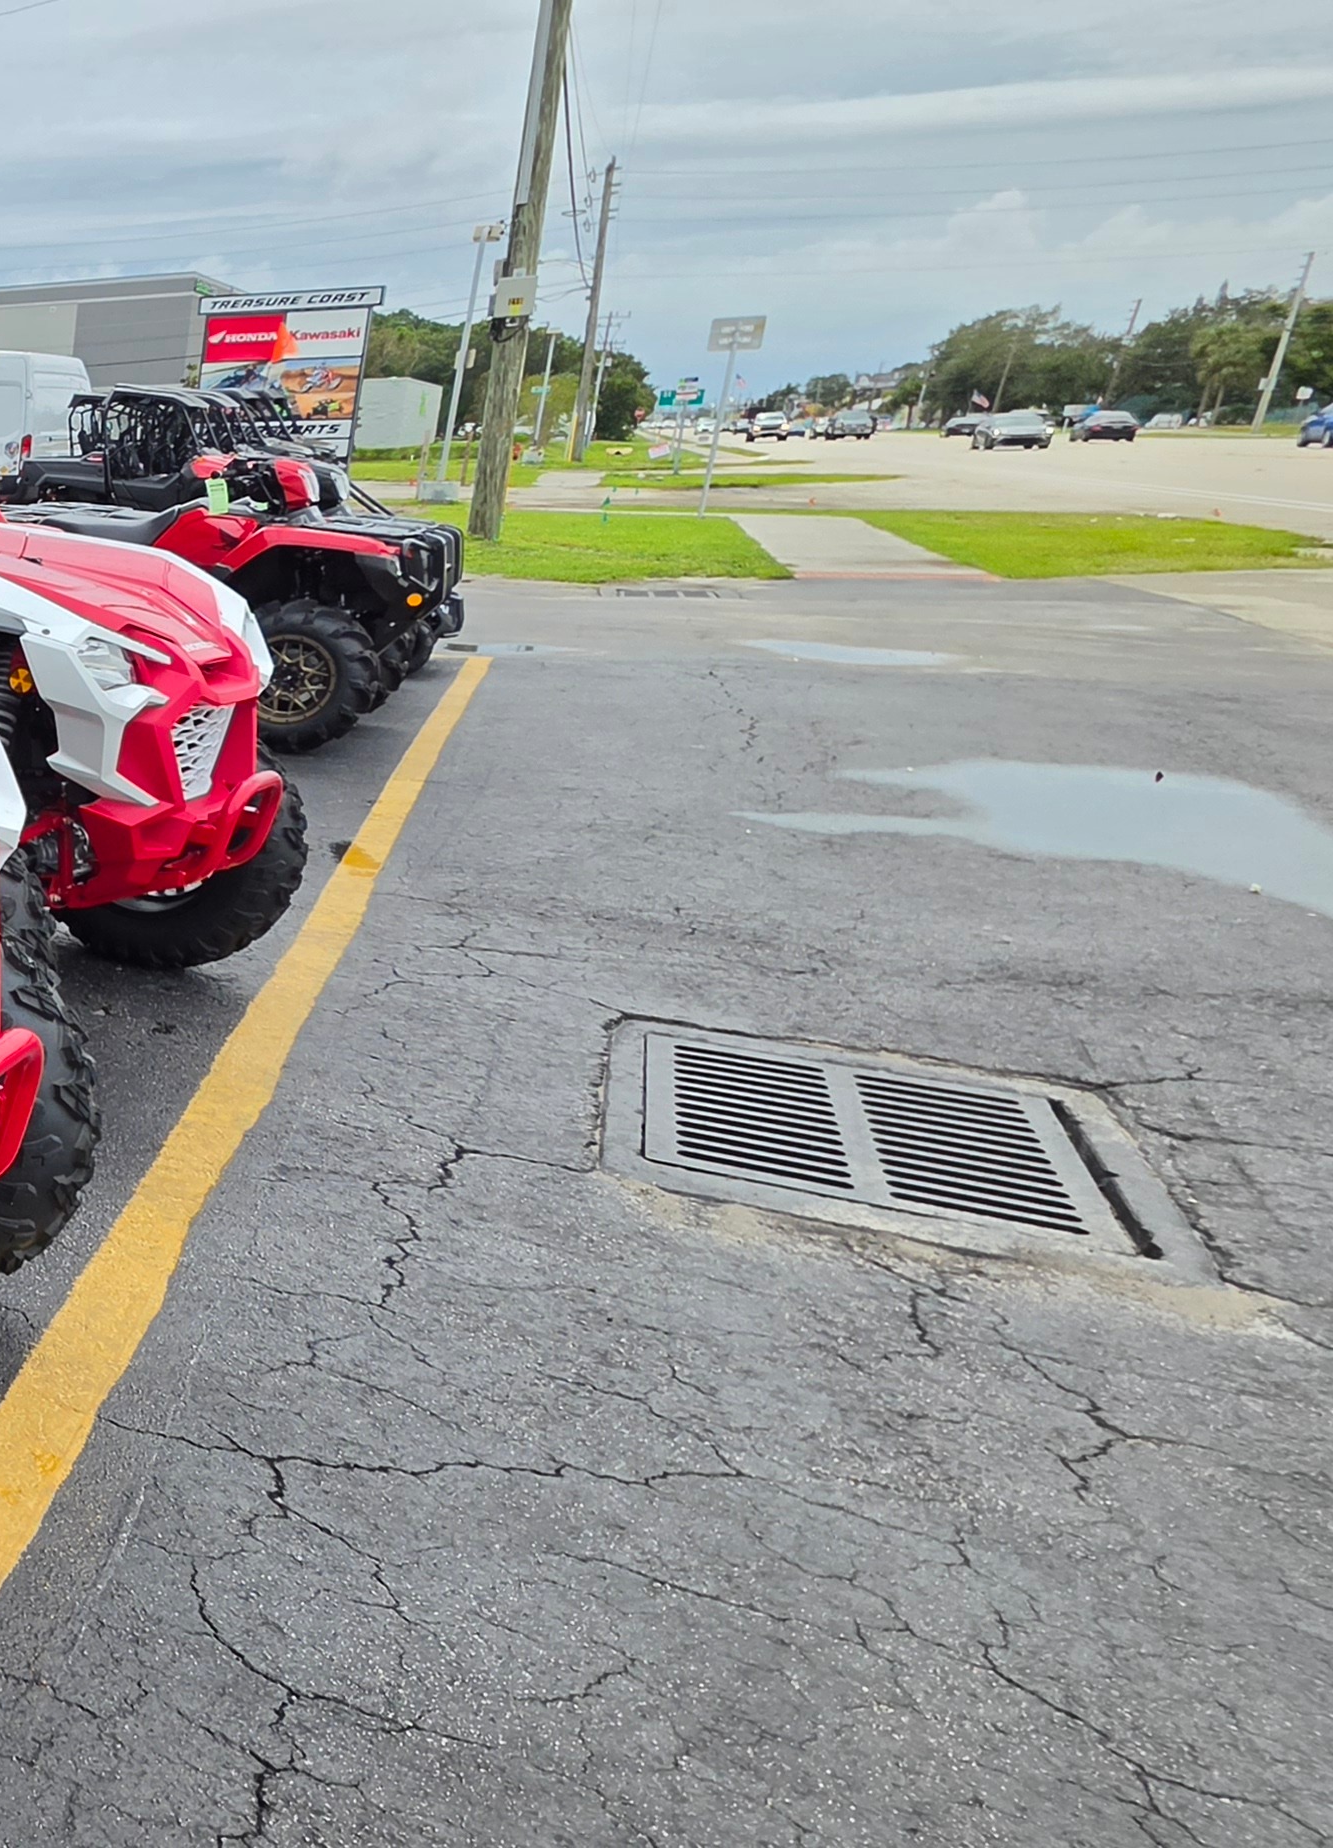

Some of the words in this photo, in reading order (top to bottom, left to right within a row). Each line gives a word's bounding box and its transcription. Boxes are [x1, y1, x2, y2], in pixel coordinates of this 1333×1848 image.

[211, 295, 302, 310] TREASURE
[307, 292, 370, 304] COAST
[224, 331, 278, 343] HONDA
[289, 327, 361, 341] Kawasaki
